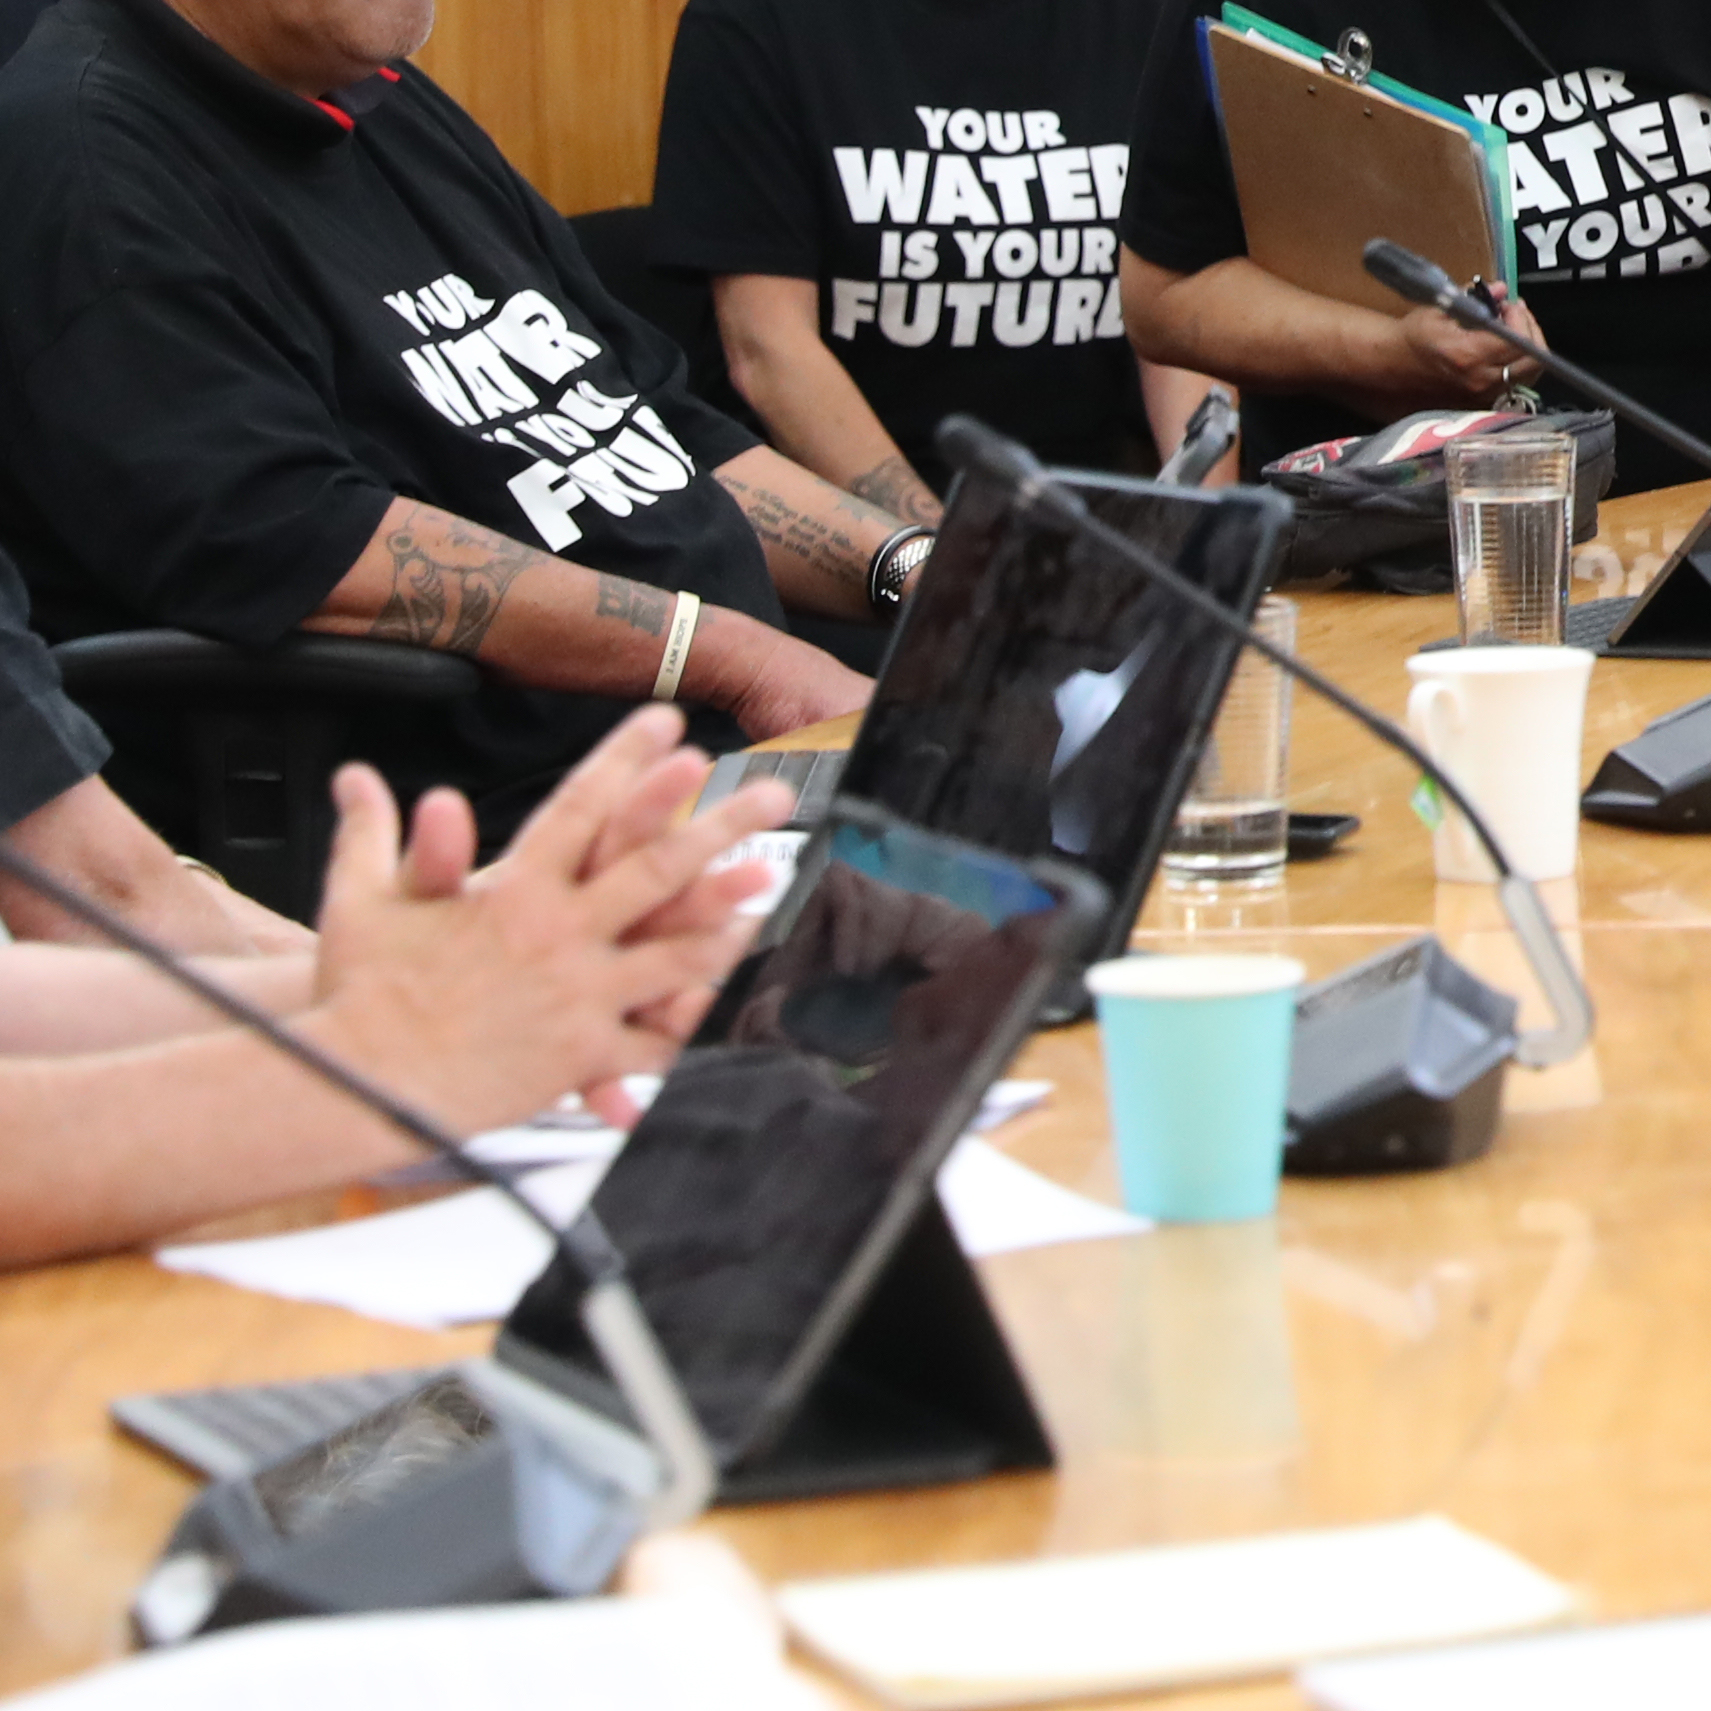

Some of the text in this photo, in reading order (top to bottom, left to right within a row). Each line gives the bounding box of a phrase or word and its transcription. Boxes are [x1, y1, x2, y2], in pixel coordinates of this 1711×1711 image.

[1463, 66, 1635, 135] YOUR
[915, 105, 1067, 154] YOUR
[879, 226, 1117, 281] IS YOUR
